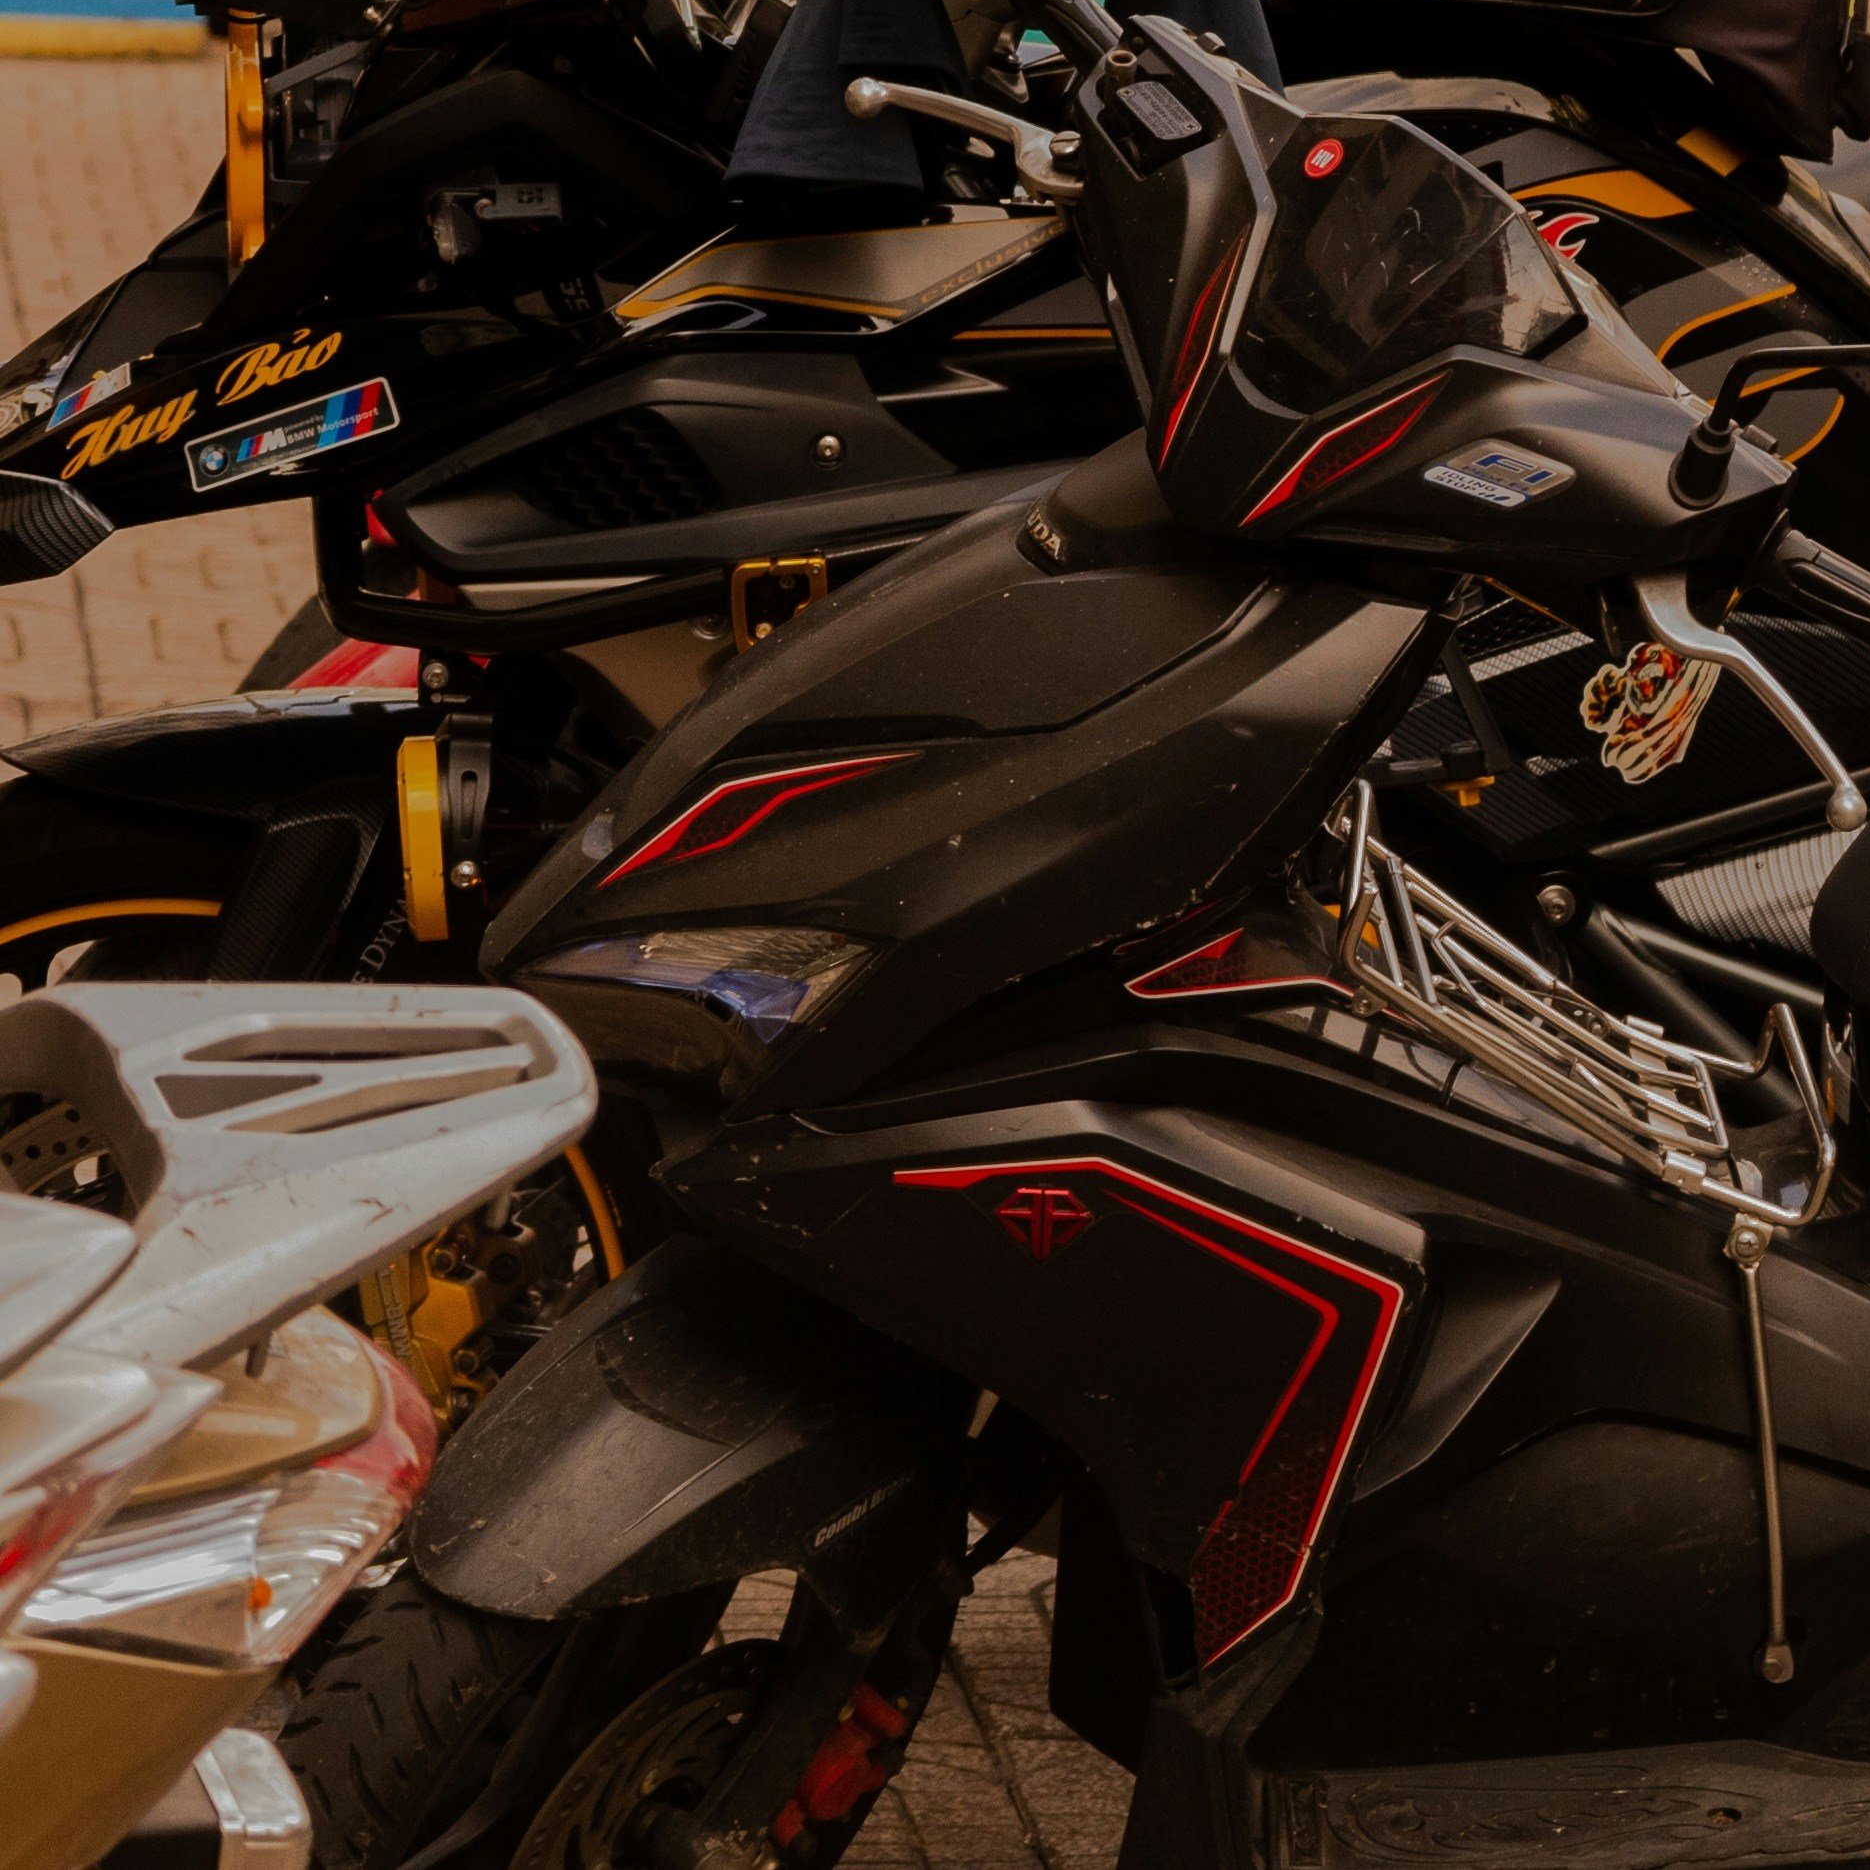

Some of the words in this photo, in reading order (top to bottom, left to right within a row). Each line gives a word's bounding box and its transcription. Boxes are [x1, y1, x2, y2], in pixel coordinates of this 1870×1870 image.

[286, 425, 315, 444] BMW
[316, 406, 380, 434] Motorsport
[1434, 475, 1477, 492] STOP
[1442, 470, 1499, 492] IDLING
